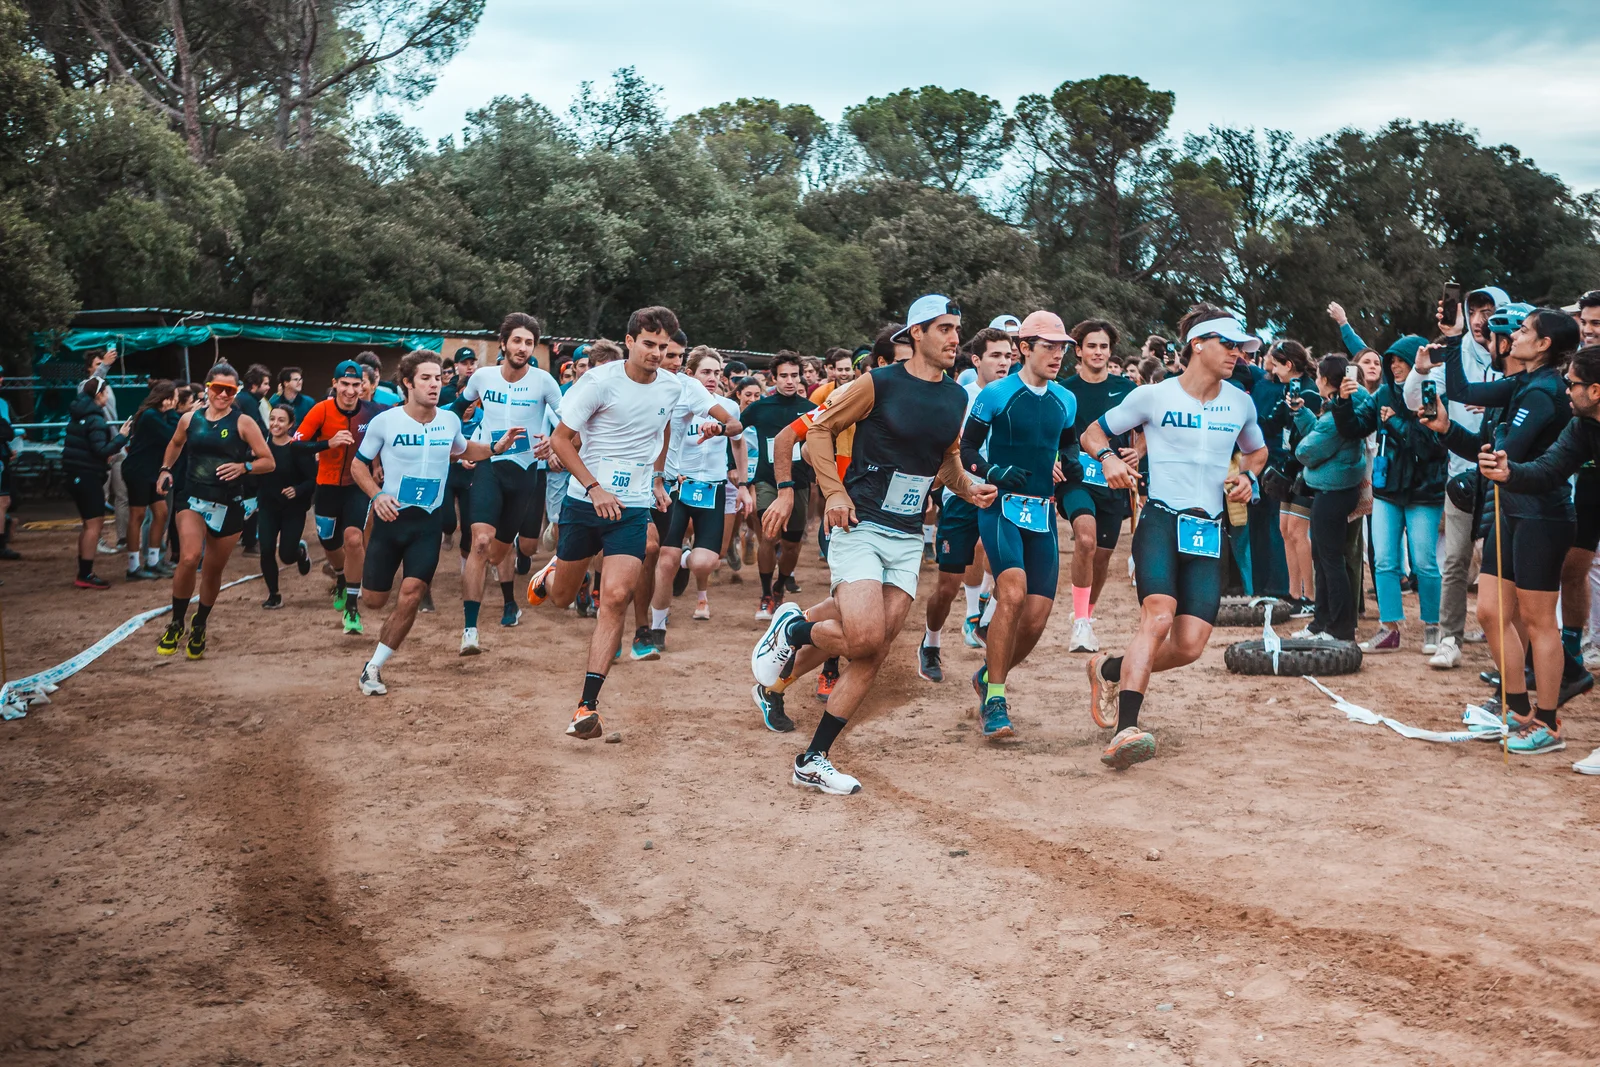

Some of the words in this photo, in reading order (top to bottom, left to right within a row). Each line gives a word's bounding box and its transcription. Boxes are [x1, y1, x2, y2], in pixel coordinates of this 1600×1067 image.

[611, 475, 631, 488] 203
[416, 491, 423, 501] 2
[692, 492, 703, 502] 50
[901, 494, 920, 506] 223
[1019, 511, 1032, 524] 24
[1192, 535, 1204, 547] 21
